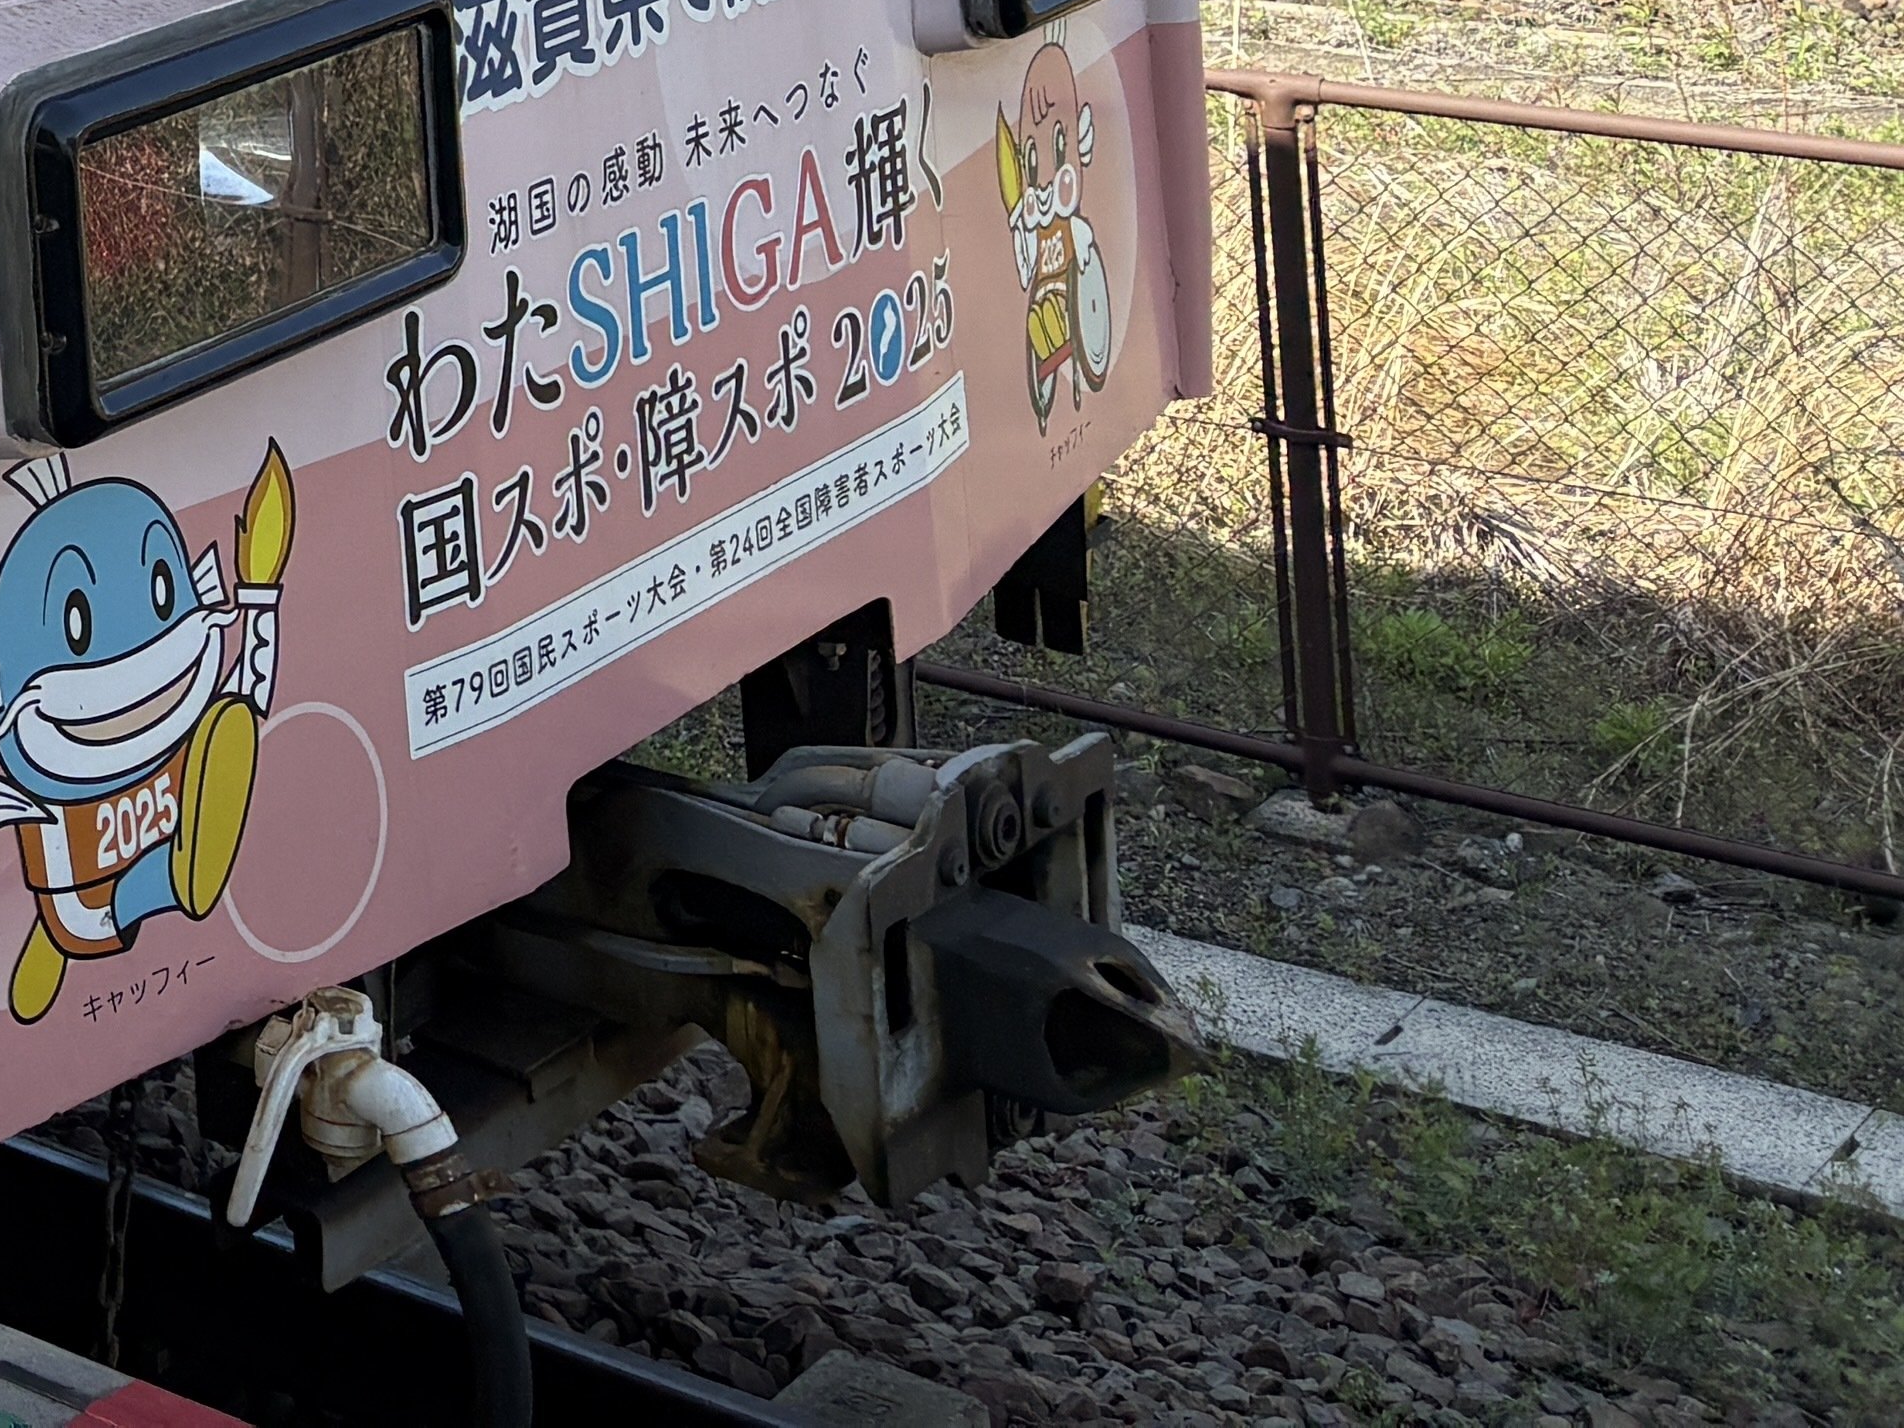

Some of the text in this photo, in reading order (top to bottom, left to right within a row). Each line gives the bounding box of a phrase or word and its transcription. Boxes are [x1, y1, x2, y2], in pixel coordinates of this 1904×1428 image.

[388, 81, 942, 456] わたSHIGA輝く
[489, 47, 869, 253] 湖国の感動 未来へつなぐ
[404, 251, 954, 627] 国スポ・障スポ 2025
[423, 402, 961, 725] 第79回国民スポーツ大会・第24回全国障害者スポーツ大会
[96, 773, 178, 869] 2025
[84, 956, 215, 1022] キャッフィー
